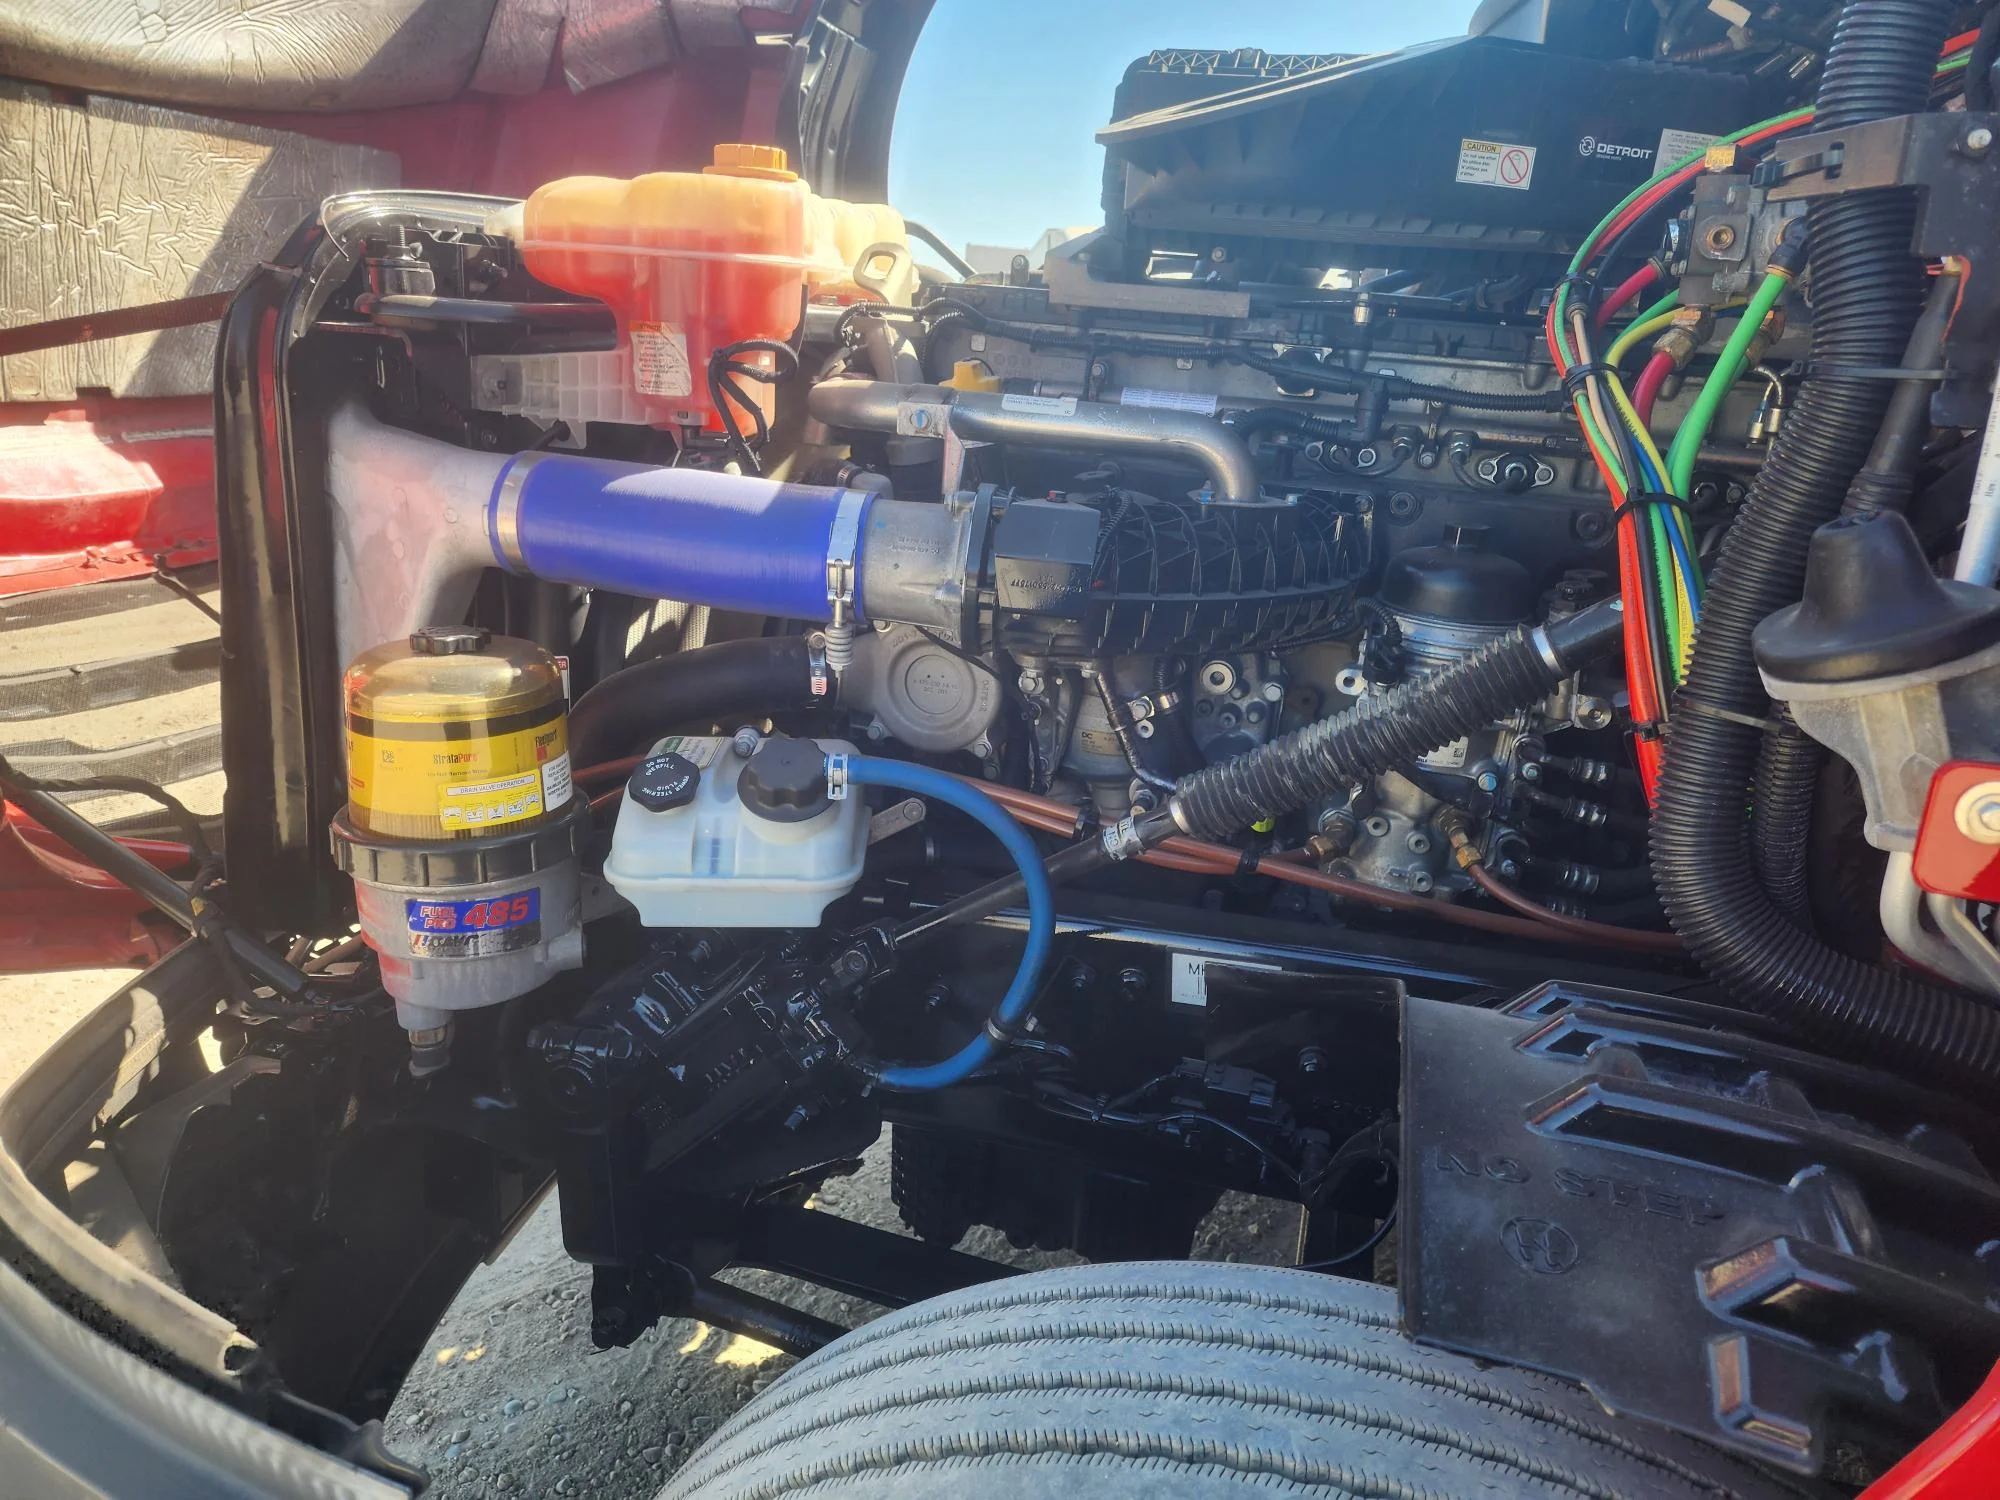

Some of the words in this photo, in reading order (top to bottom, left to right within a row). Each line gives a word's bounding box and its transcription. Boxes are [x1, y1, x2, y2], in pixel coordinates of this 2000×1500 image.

[1467, 143, 1497, 153] CAUTION
[1596, 143, 1653, 160] DETROIT
[645, 762, 675, 776] OVERFILL
[460, 786, 478, 794] DRAIN
[479, 784, 496, 792] VALVE
[496, 778, 525, 790] OPERATION
[656, 781, 678, 791] FLUID
[674, 775, 690, 792] POWER
[419, 905, 458, 919] FUEL
[462, 895, 529, 929] 485
[424, 917, 456, 929] PRO
[1435, 1146, 1530, 1184] NO
[1554, 1167, 1725, 1227] STEP
